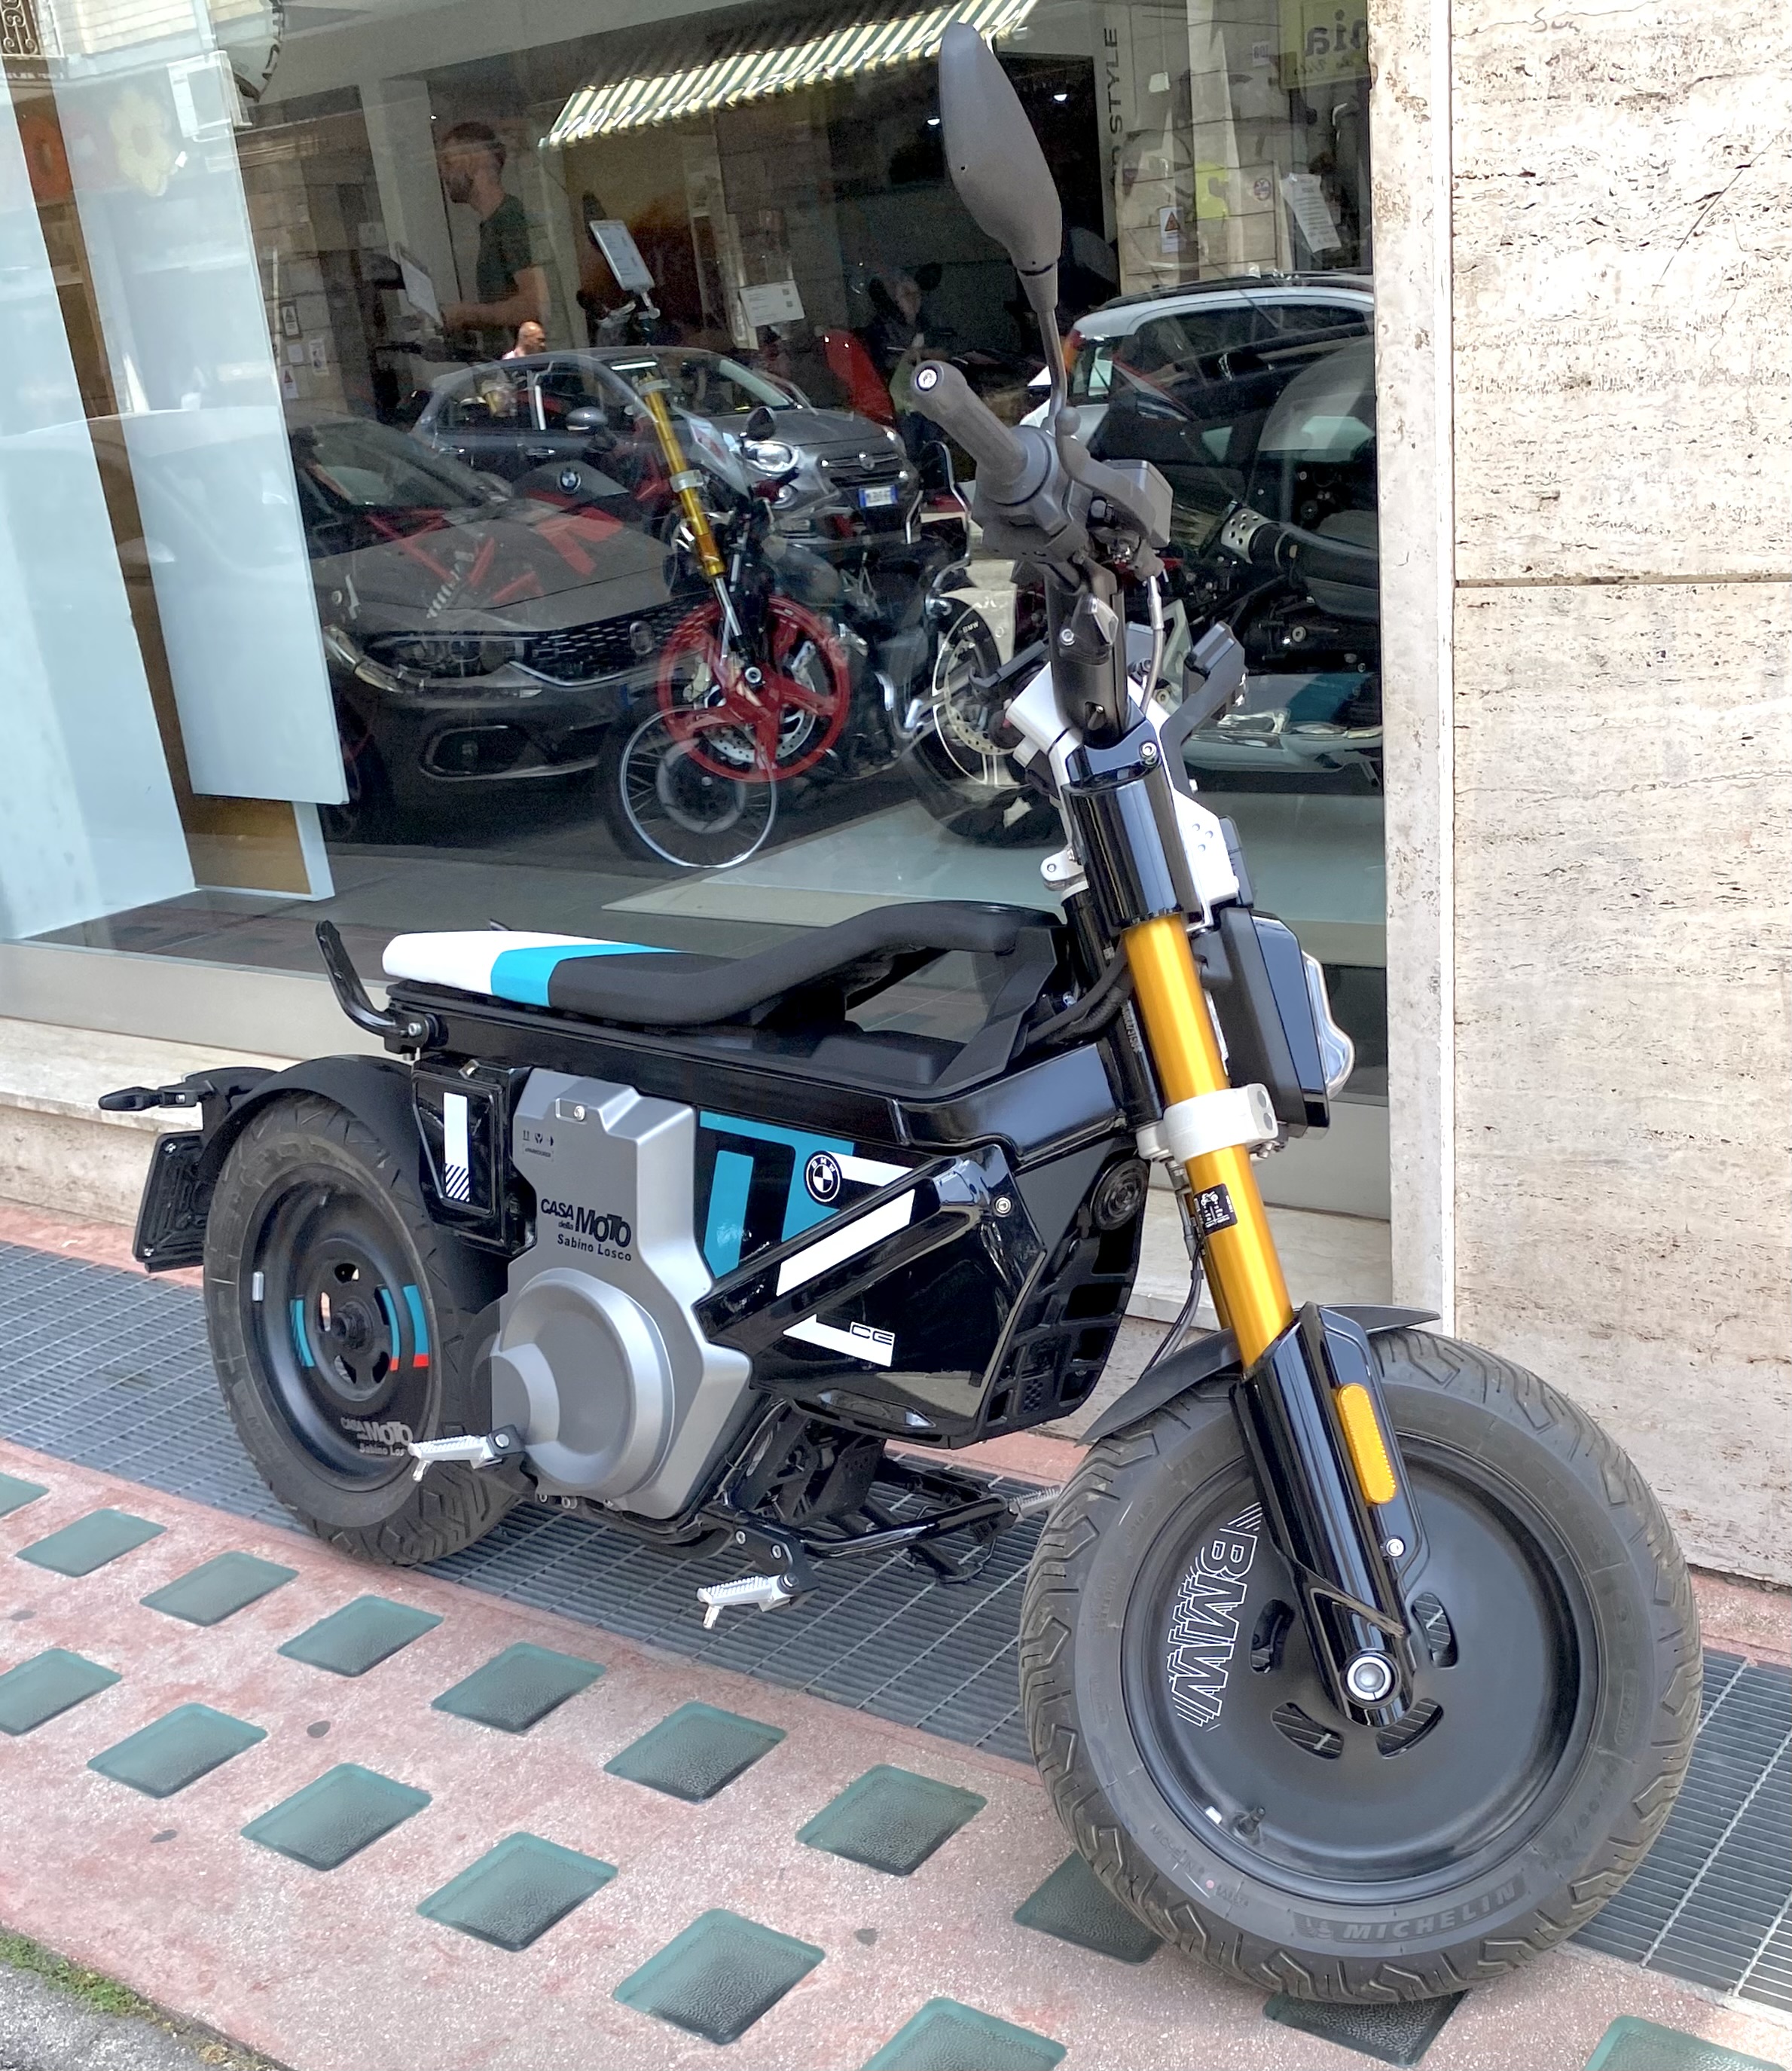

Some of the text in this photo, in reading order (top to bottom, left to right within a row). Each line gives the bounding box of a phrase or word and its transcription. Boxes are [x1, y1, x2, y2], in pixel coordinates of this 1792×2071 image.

[1104, 28, 1122, 134] STYLE
[962, 621, 978, 633] BMW
[811, 1157, 835, 1172] BMW
[541, 1199, 574, 1220] CASA
[558, 1220, 573, 1230] della
[557, 1233, 631, 1261] Sabino Losco
[1168, 1526, 1259, 1727] BMW
[1343, 1882, 1516, 1940] MICHELIN
